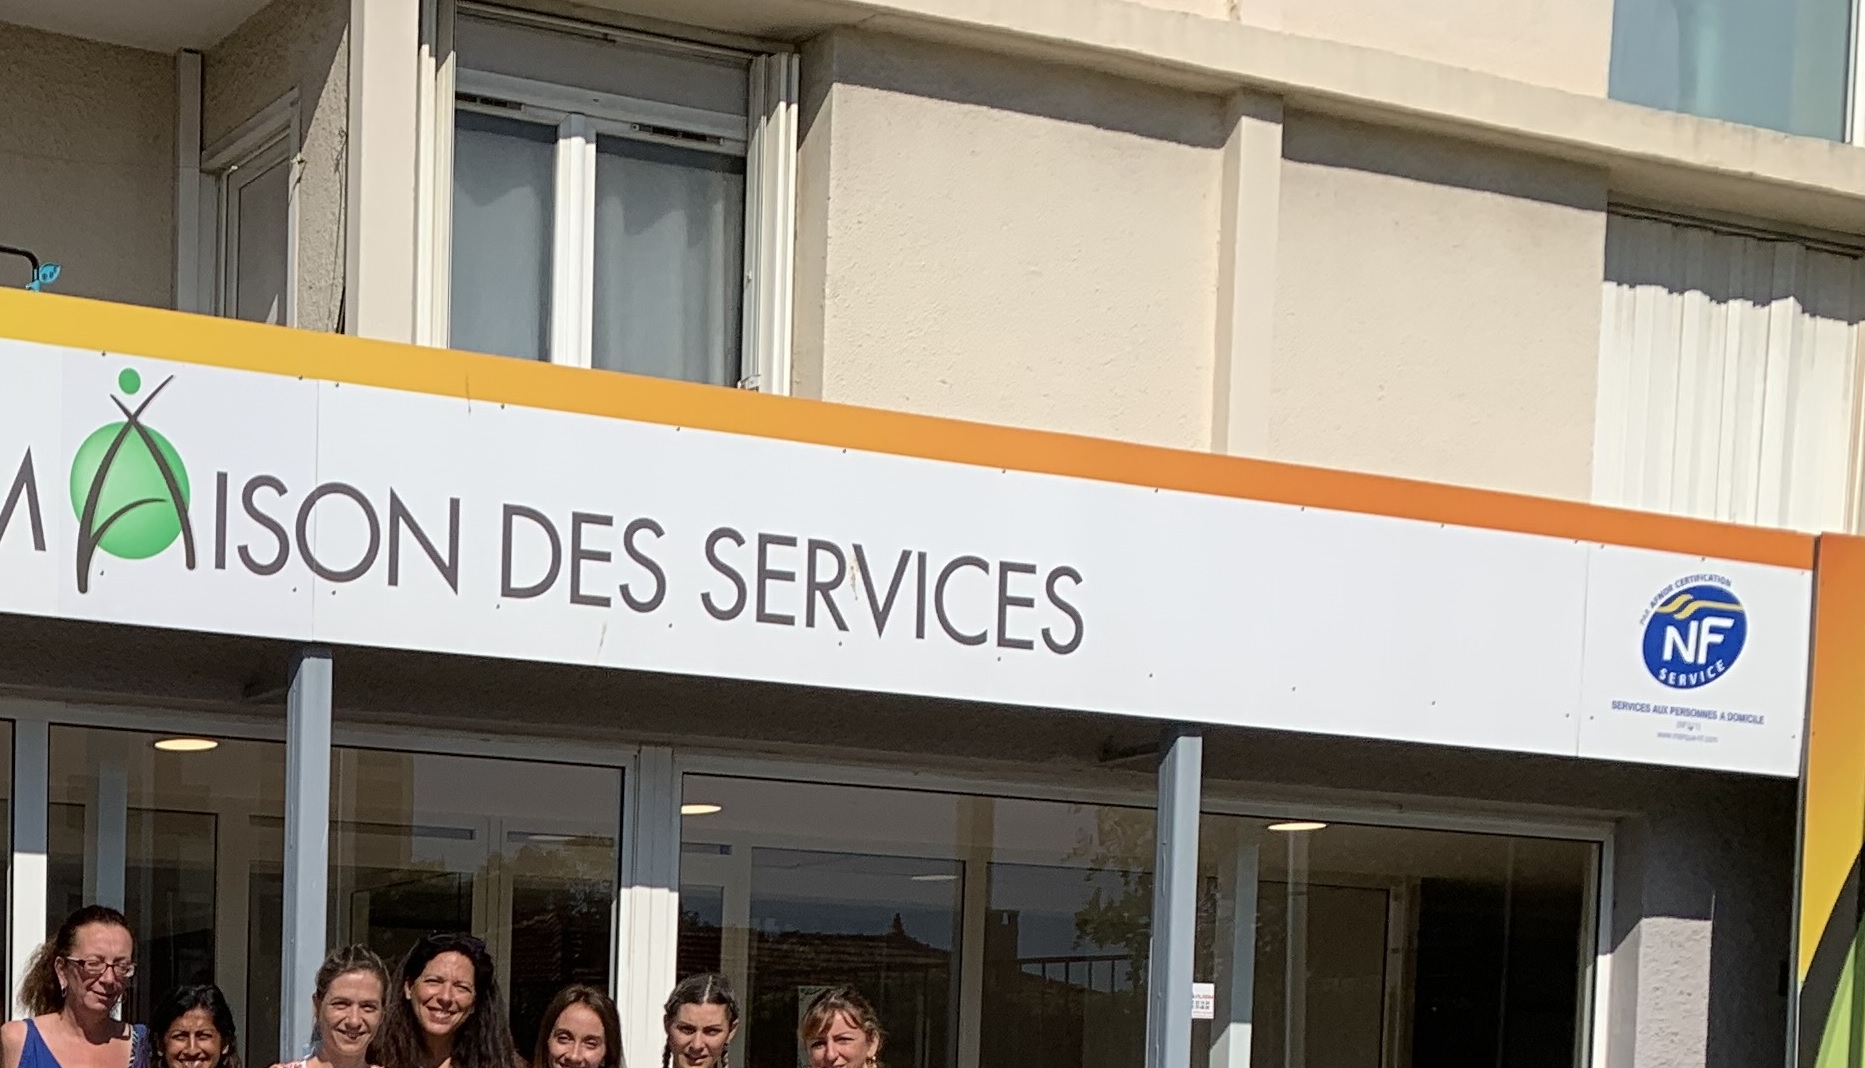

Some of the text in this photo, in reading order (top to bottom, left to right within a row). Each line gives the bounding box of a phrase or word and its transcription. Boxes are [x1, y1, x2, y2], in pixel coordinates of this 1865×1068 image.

[500, 503, 667, 614] DES
[700, 526, 1085, 655] SERVICES
[1650, 583, 1674, 608] AFNOR
[1674, 573, 1732, 589] CERTIFICATION
[1662, 615, 1735, 665] NF
[1658, 659, 1725, 687] SERVICE
[1611, 700, 1651, 713] SERVICES
[1652, 704, 1669, 715] AUX
[1670, 706, 1717, 720] PERSONNES
[1727, 712, 1765, 725] DOMICILE
